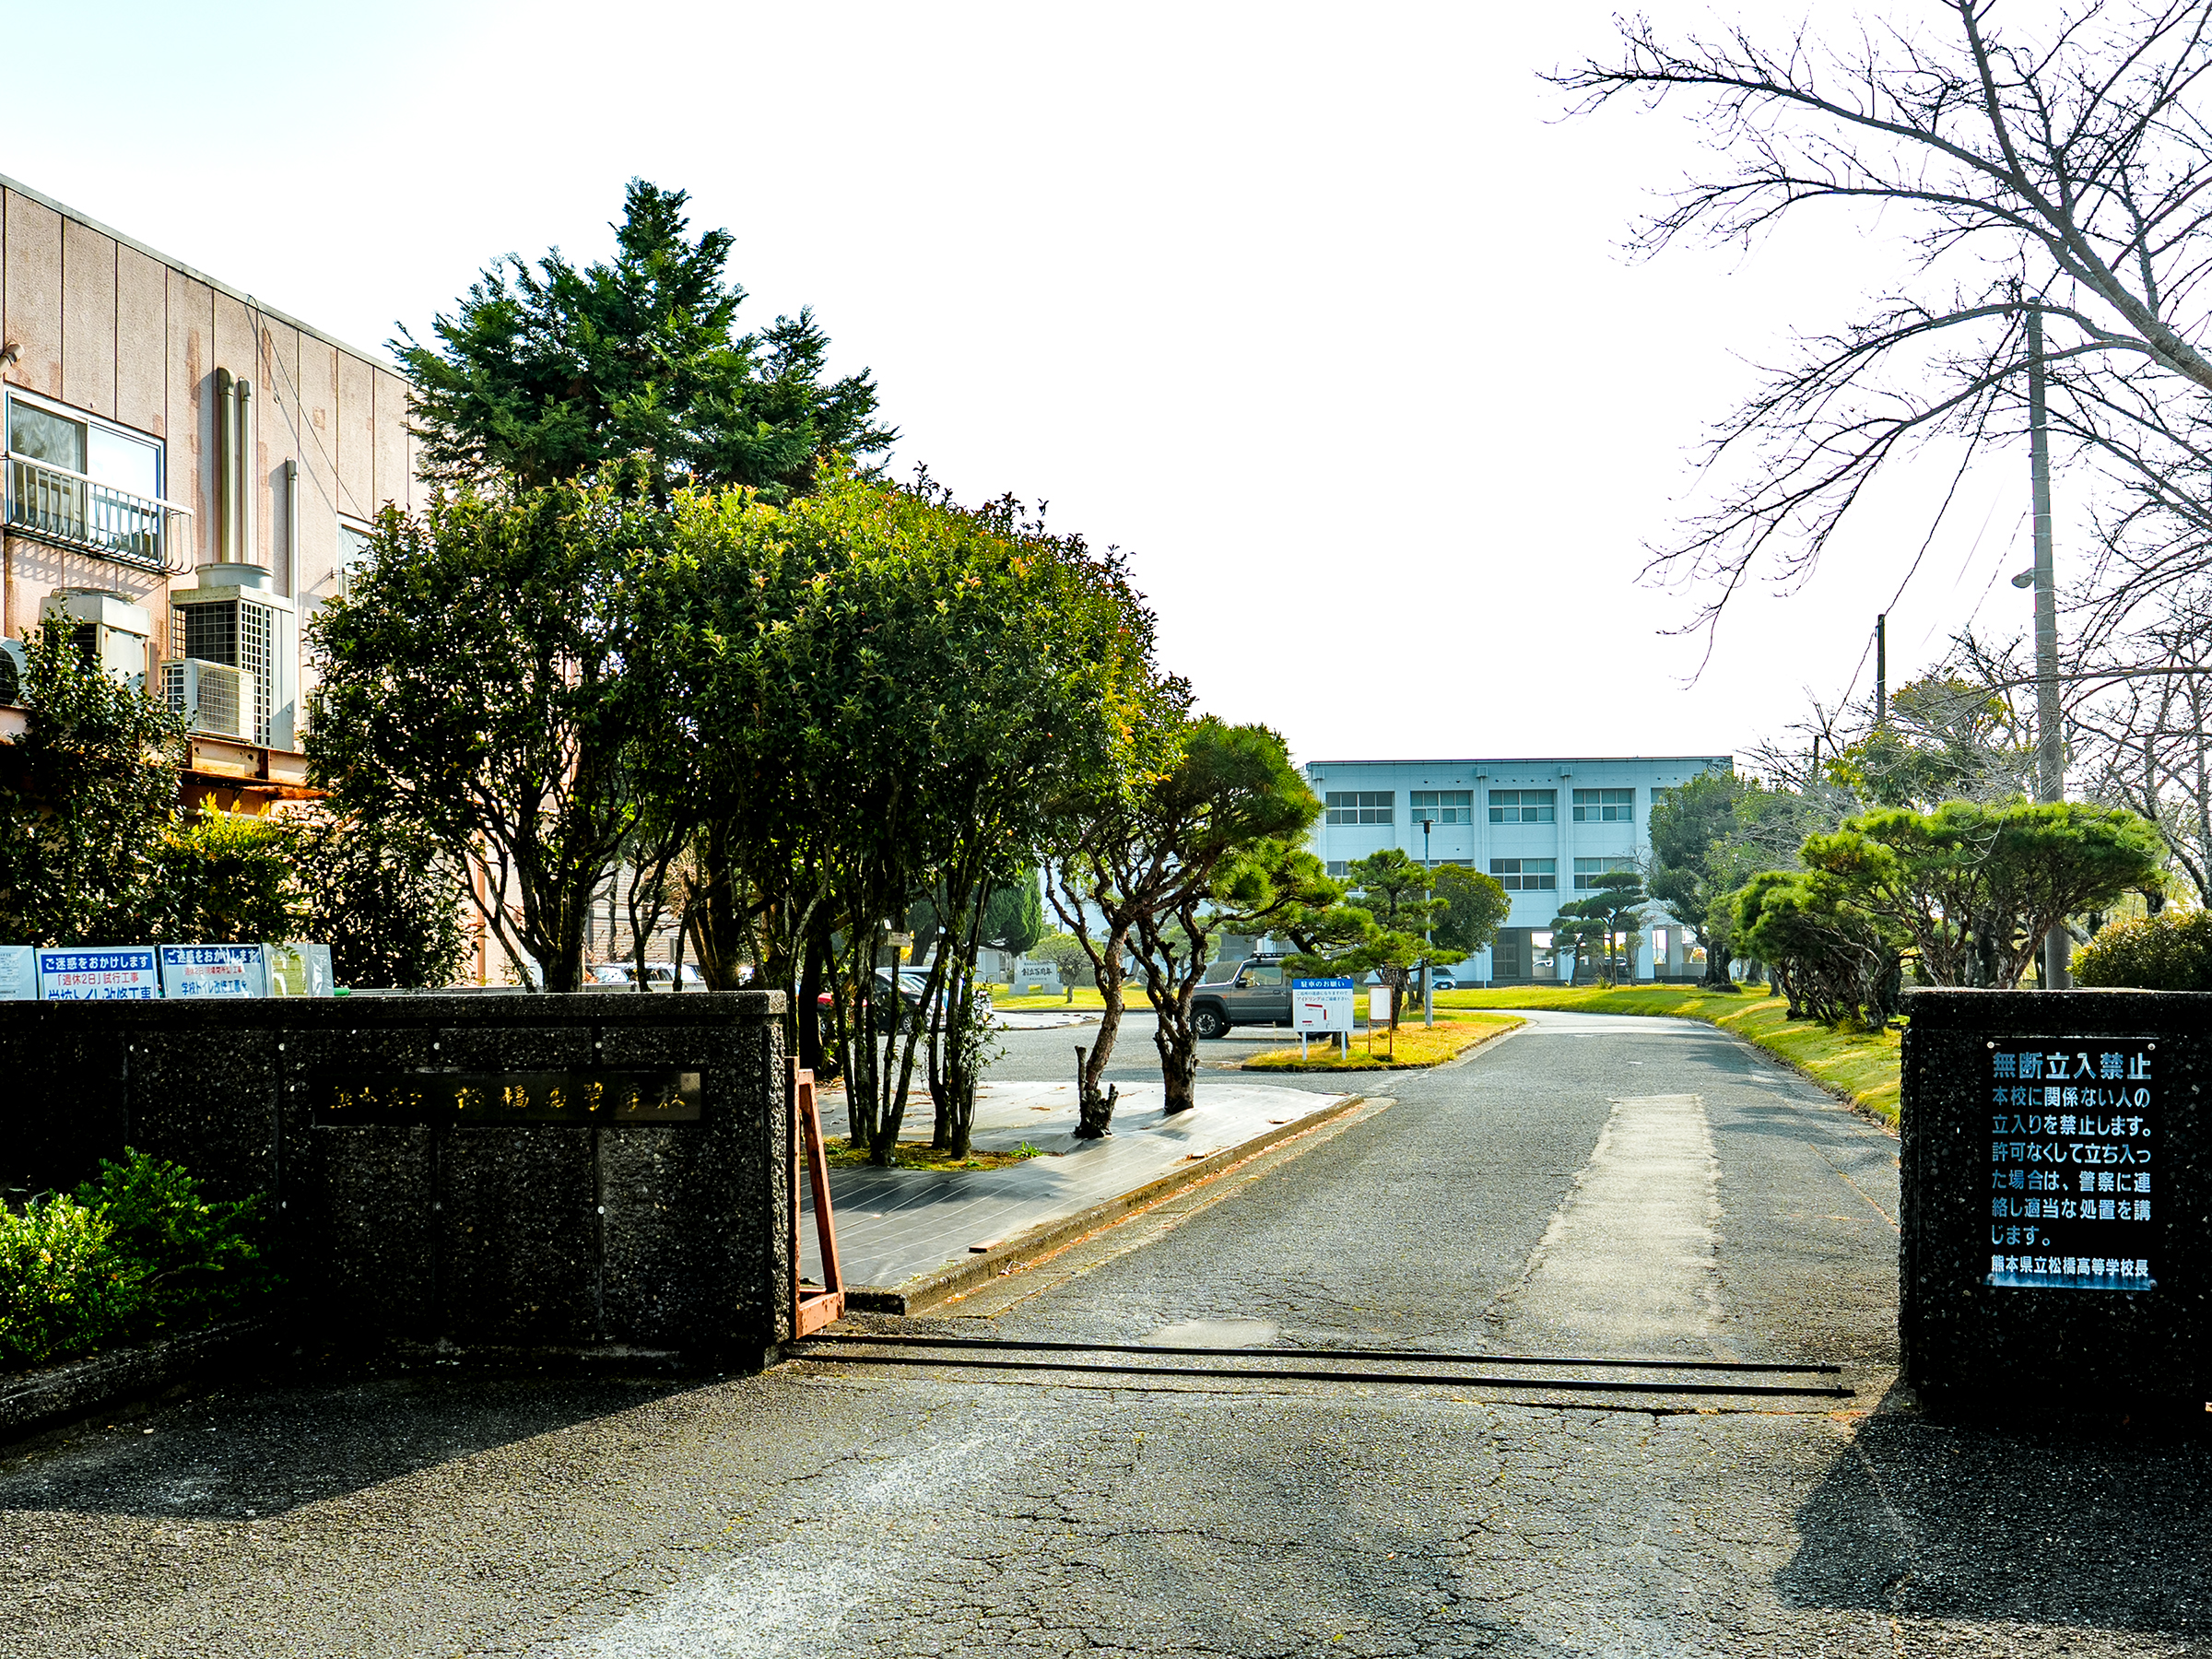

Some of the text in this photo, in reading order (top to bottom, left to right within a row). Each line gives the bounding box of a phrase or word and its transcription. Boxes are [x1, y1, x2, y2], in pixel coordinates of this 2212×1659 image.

[45, 956, 148, 971] ご迷惑をおかけします
[57, 971, 139, 985] 「週休2日」試行工事
[1993, 1052, 2152, 1079] 無断立入禁止
[1992, 1086, 2150, 1108] 本校に関係ない人の
[1992, 1113, 2151, 1136] 立入りを禁止します。
[1992, 1142, 2152, 1164] 許可なくして立ち入っ
[1992, 1197, 2151, 1221] 絡し適当な処置を講
[1992, 1225, 2051, 1246] じます。
[1991, 1254, 2149, 1277] 熊本県立松橋高等学校長
